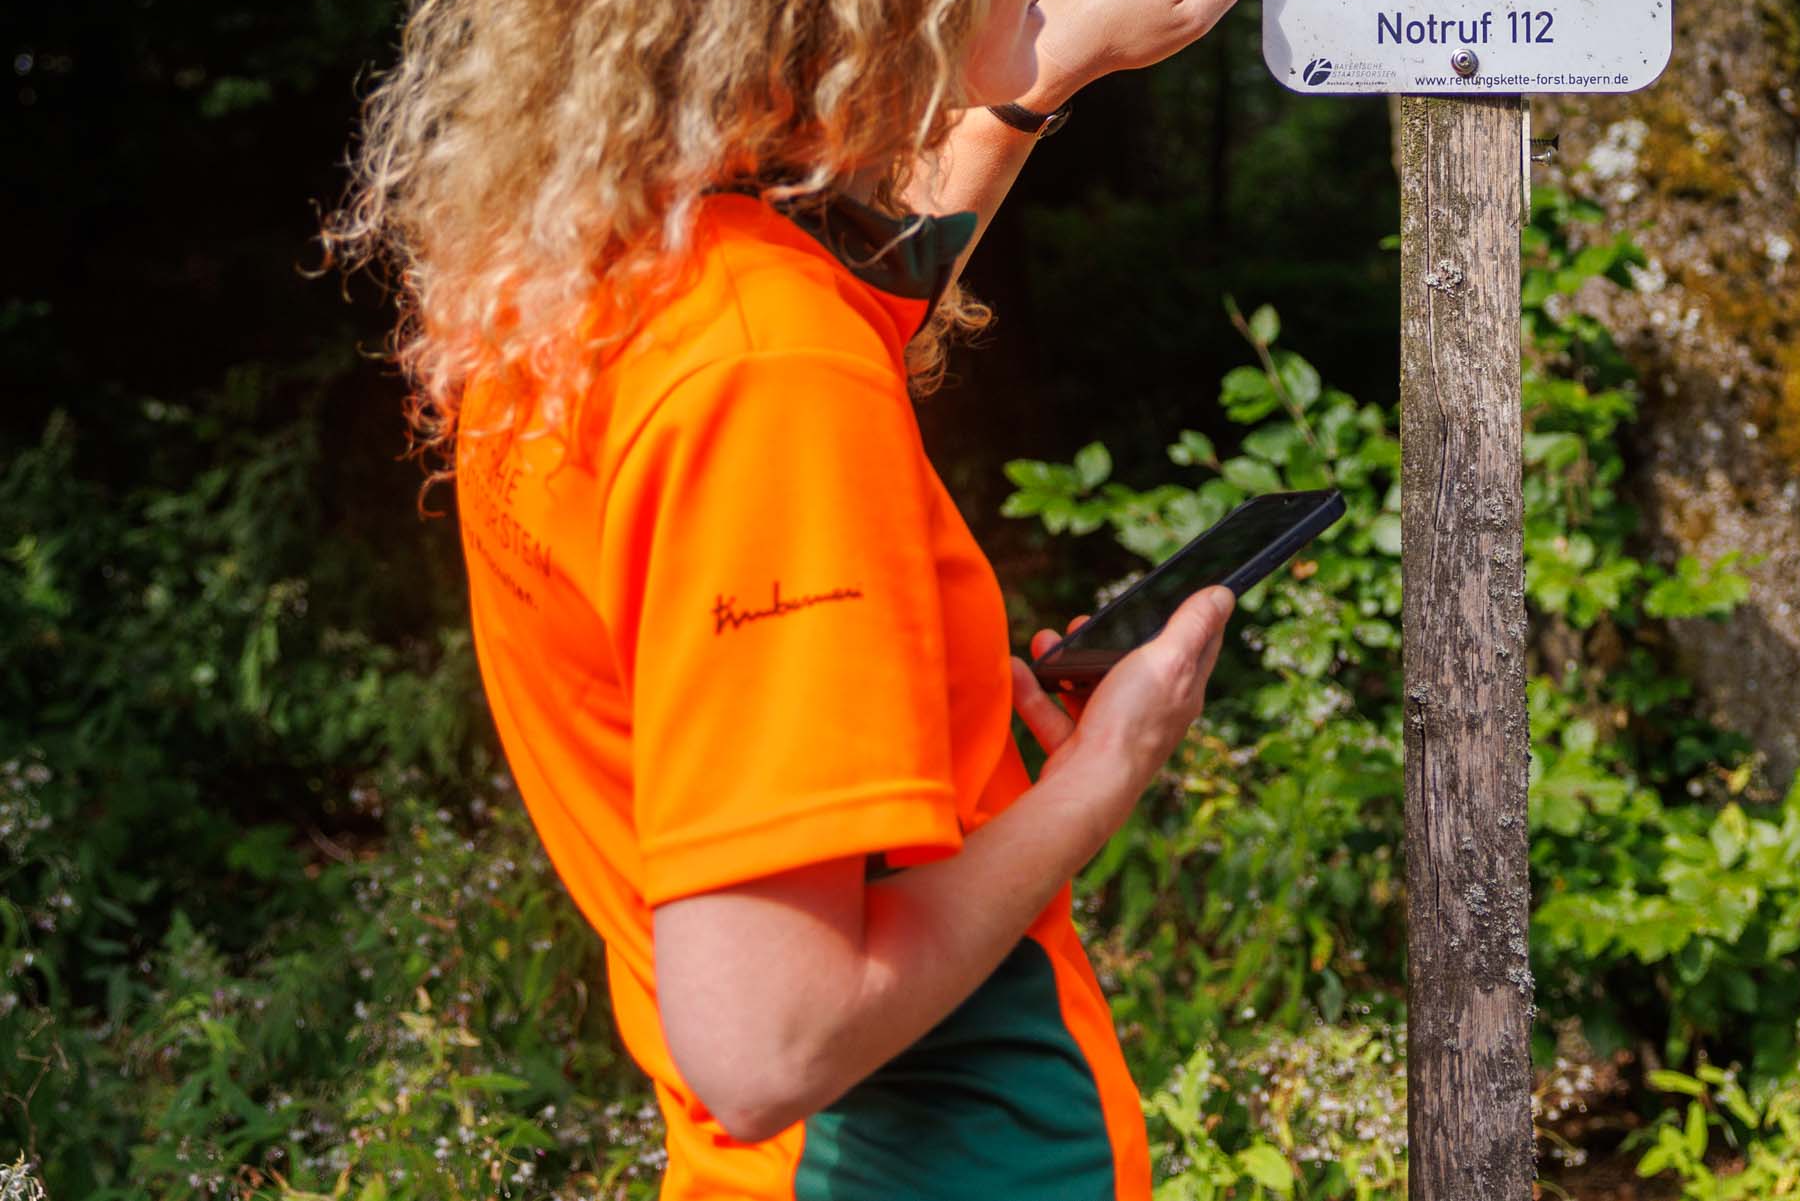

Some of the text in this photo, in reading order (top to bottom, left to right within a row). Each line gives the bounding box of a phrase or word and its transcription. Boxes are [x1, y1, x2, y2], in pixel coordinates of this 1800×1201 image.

[1376, 10, 1554, 44] Notruf 112
[1415, 73, 1628, 87] www.rettungskette-forst.bayern.de
